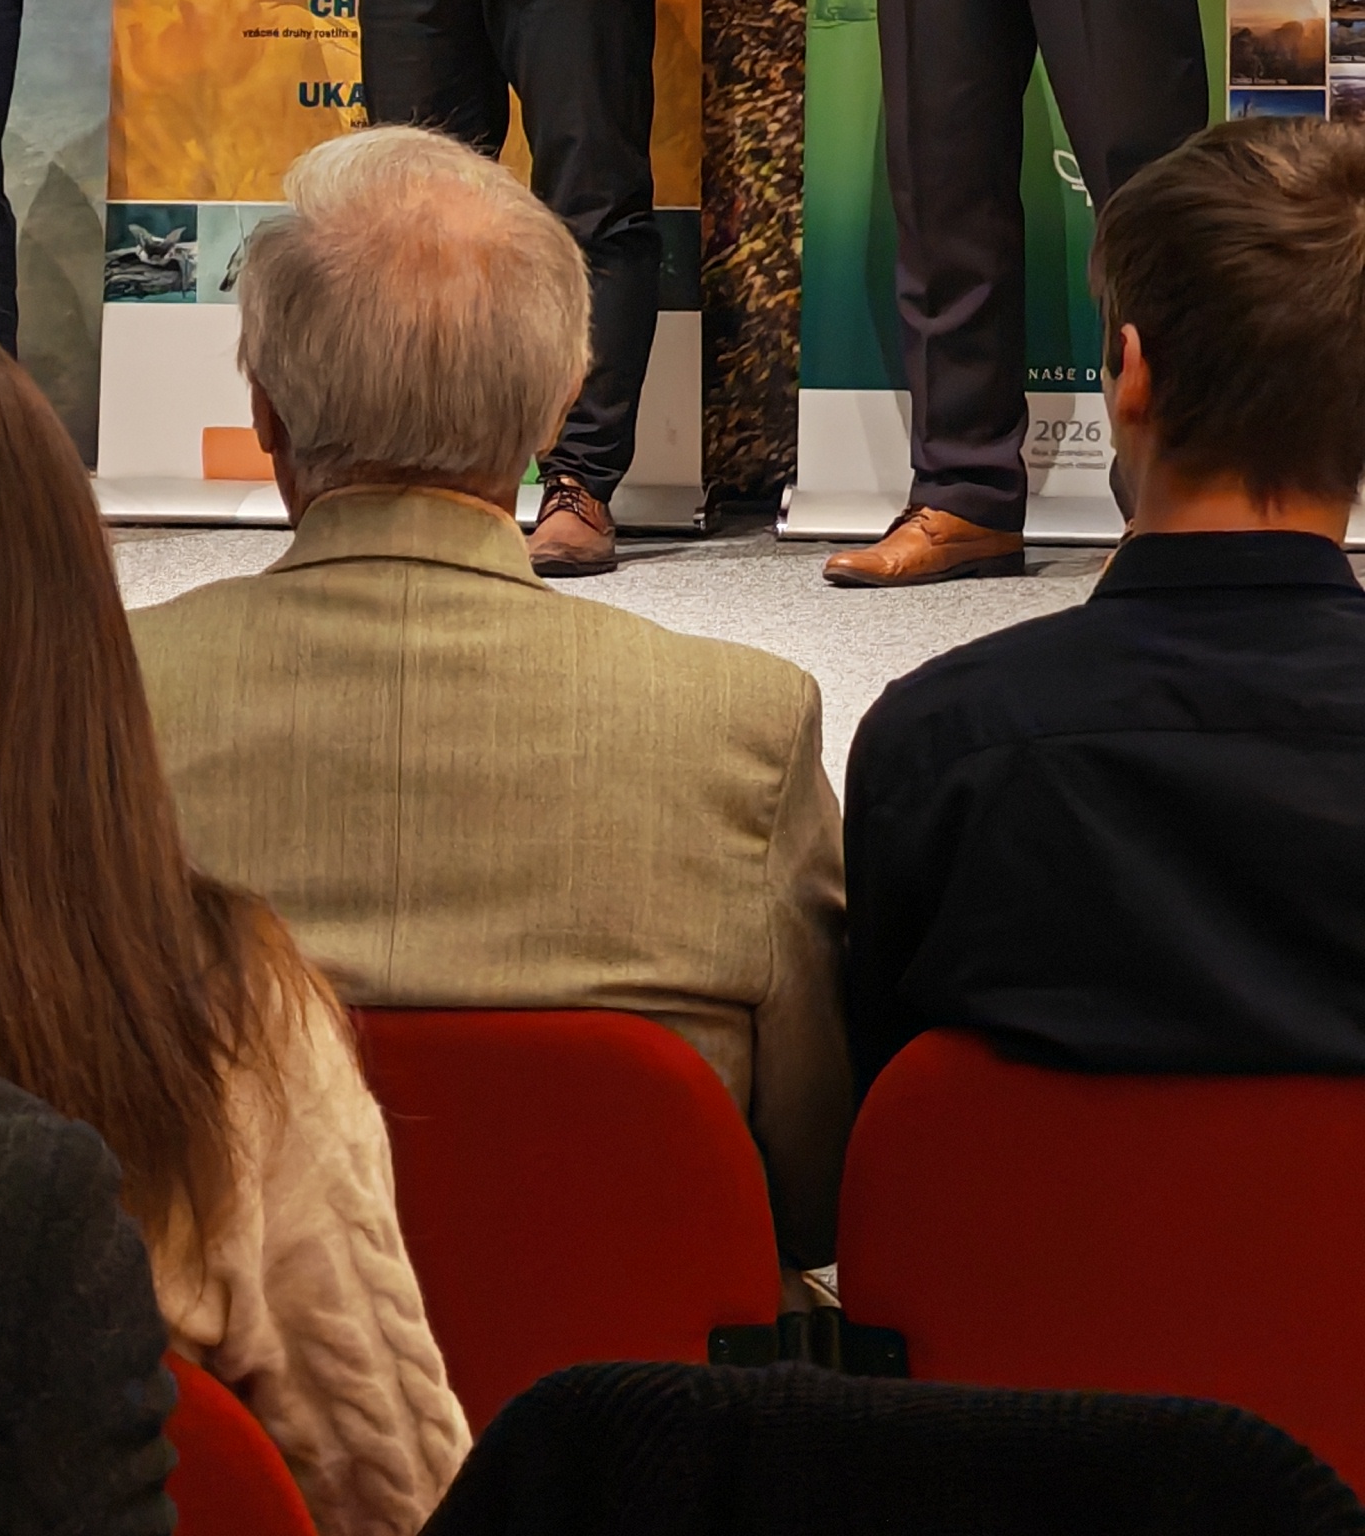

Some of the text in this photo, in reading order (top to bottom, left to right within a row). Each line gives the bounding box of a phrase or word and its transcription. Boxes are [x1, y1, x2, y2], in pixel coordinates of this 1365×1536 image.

[282, 28, 311, 39] druhy
[299, 82, 365, 107] UKA
[1034, 420, 1101, 441] 2026
